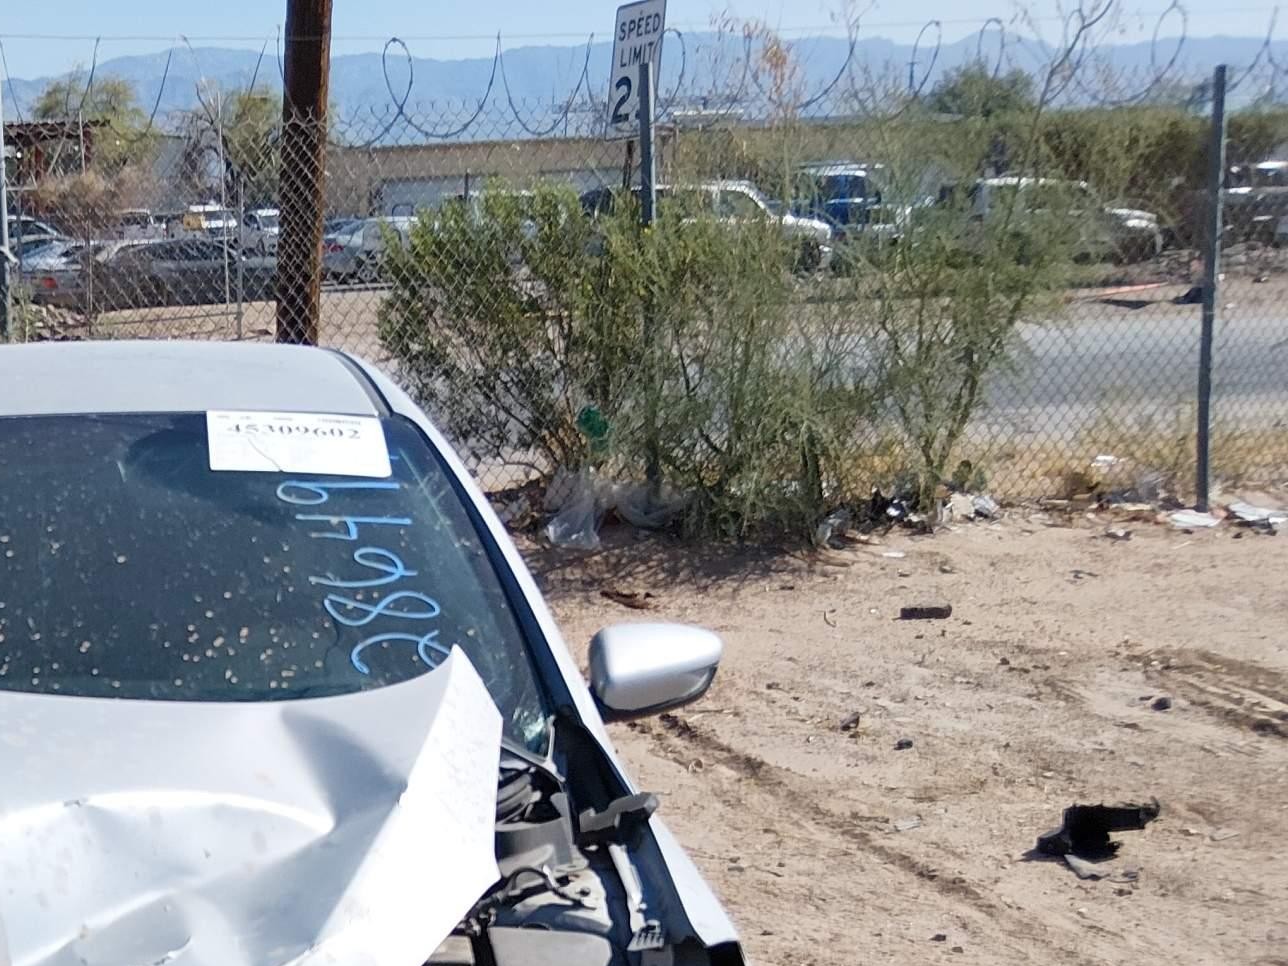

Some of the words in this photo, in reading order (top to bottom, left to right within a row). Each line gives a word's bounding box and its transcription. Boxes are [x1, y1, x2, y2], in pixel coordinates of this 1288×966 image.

[618, 12, 661, 42] SPEED
[620, 42, 654, 68] LIMIT
[611, 76, 640, 125] 2
[227, 422, 362, 441] 45309602
